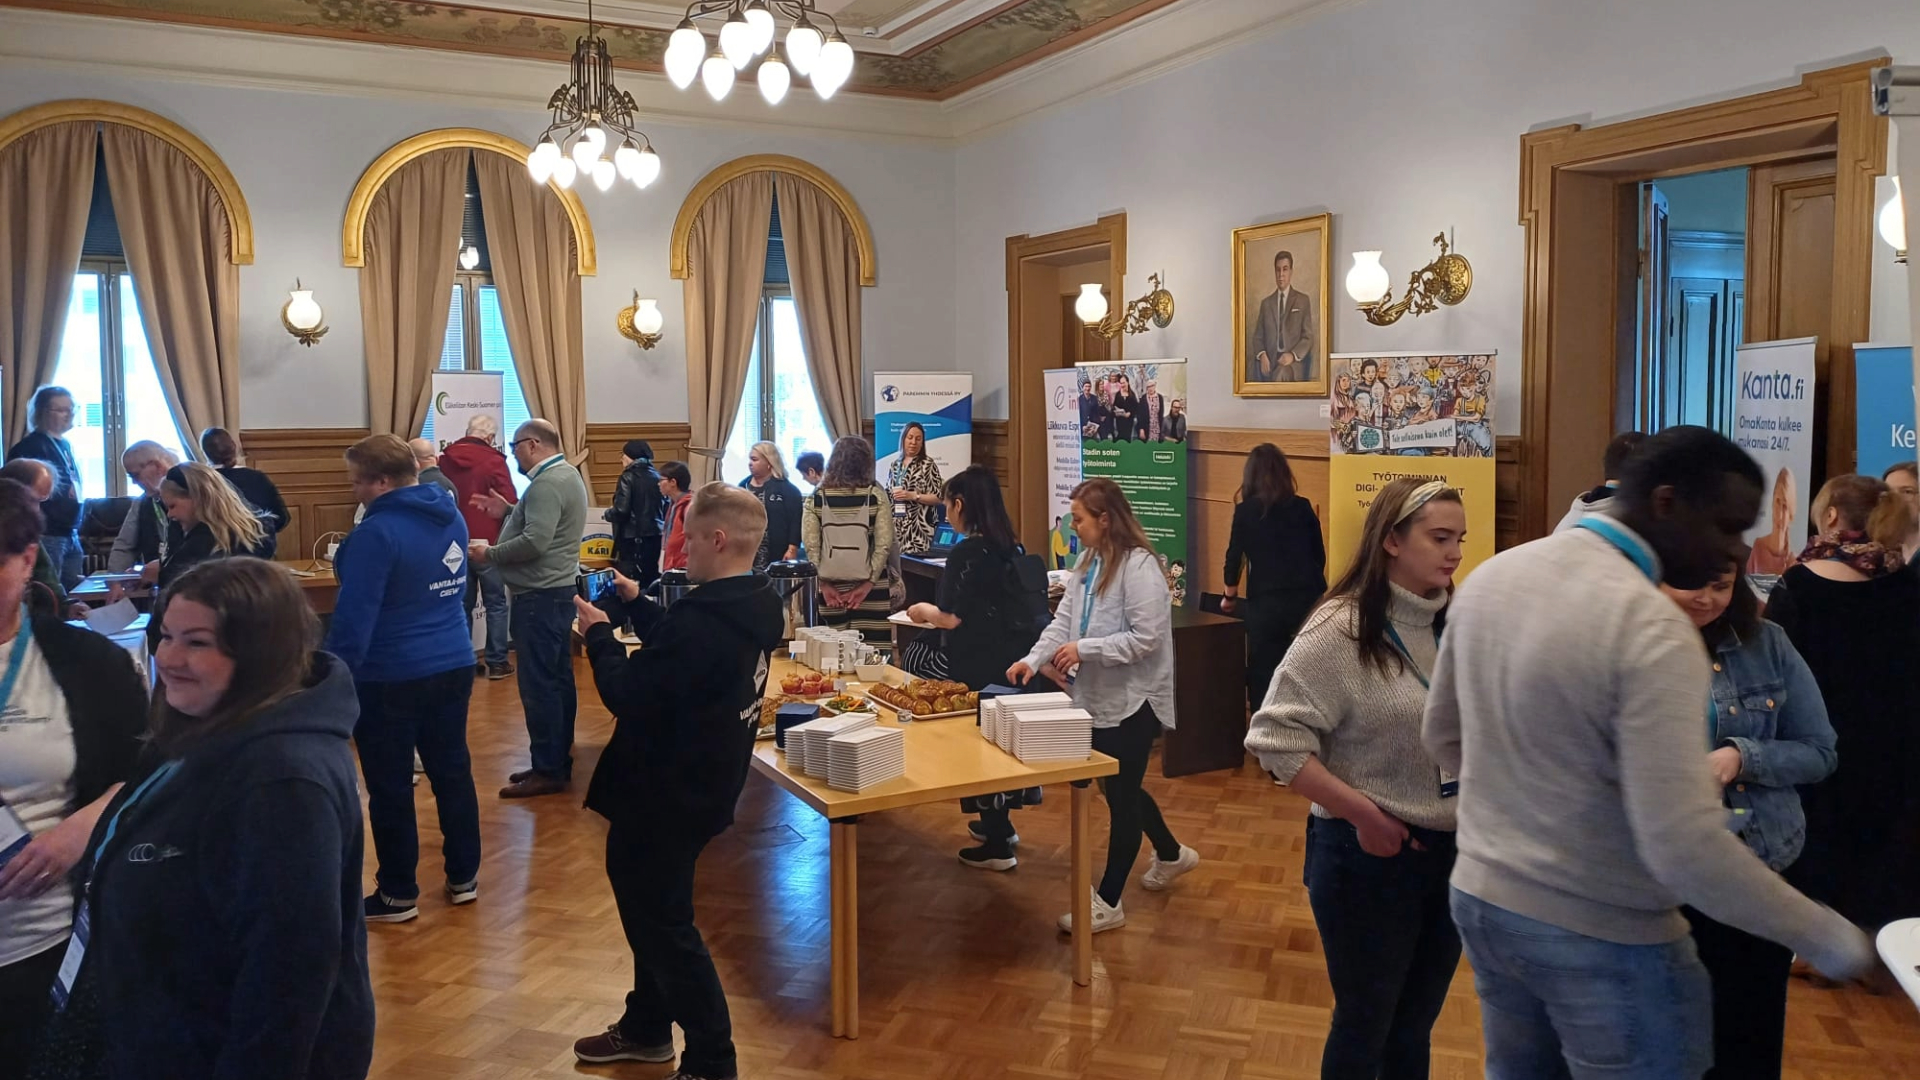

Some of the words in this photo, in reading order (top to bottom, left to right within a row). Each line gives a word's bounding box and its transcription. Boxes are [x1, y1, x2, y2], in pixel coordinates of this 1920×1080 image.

[1741, 370, 1804, 400] Kanta.fi
[1739, 415, 1776, 430] OmaKanta
[1778, 416, 1802, 431] kulkee
[1425, 429, 1438, 439] kuin
[1355, 483, 1379, 492] DIGI-
